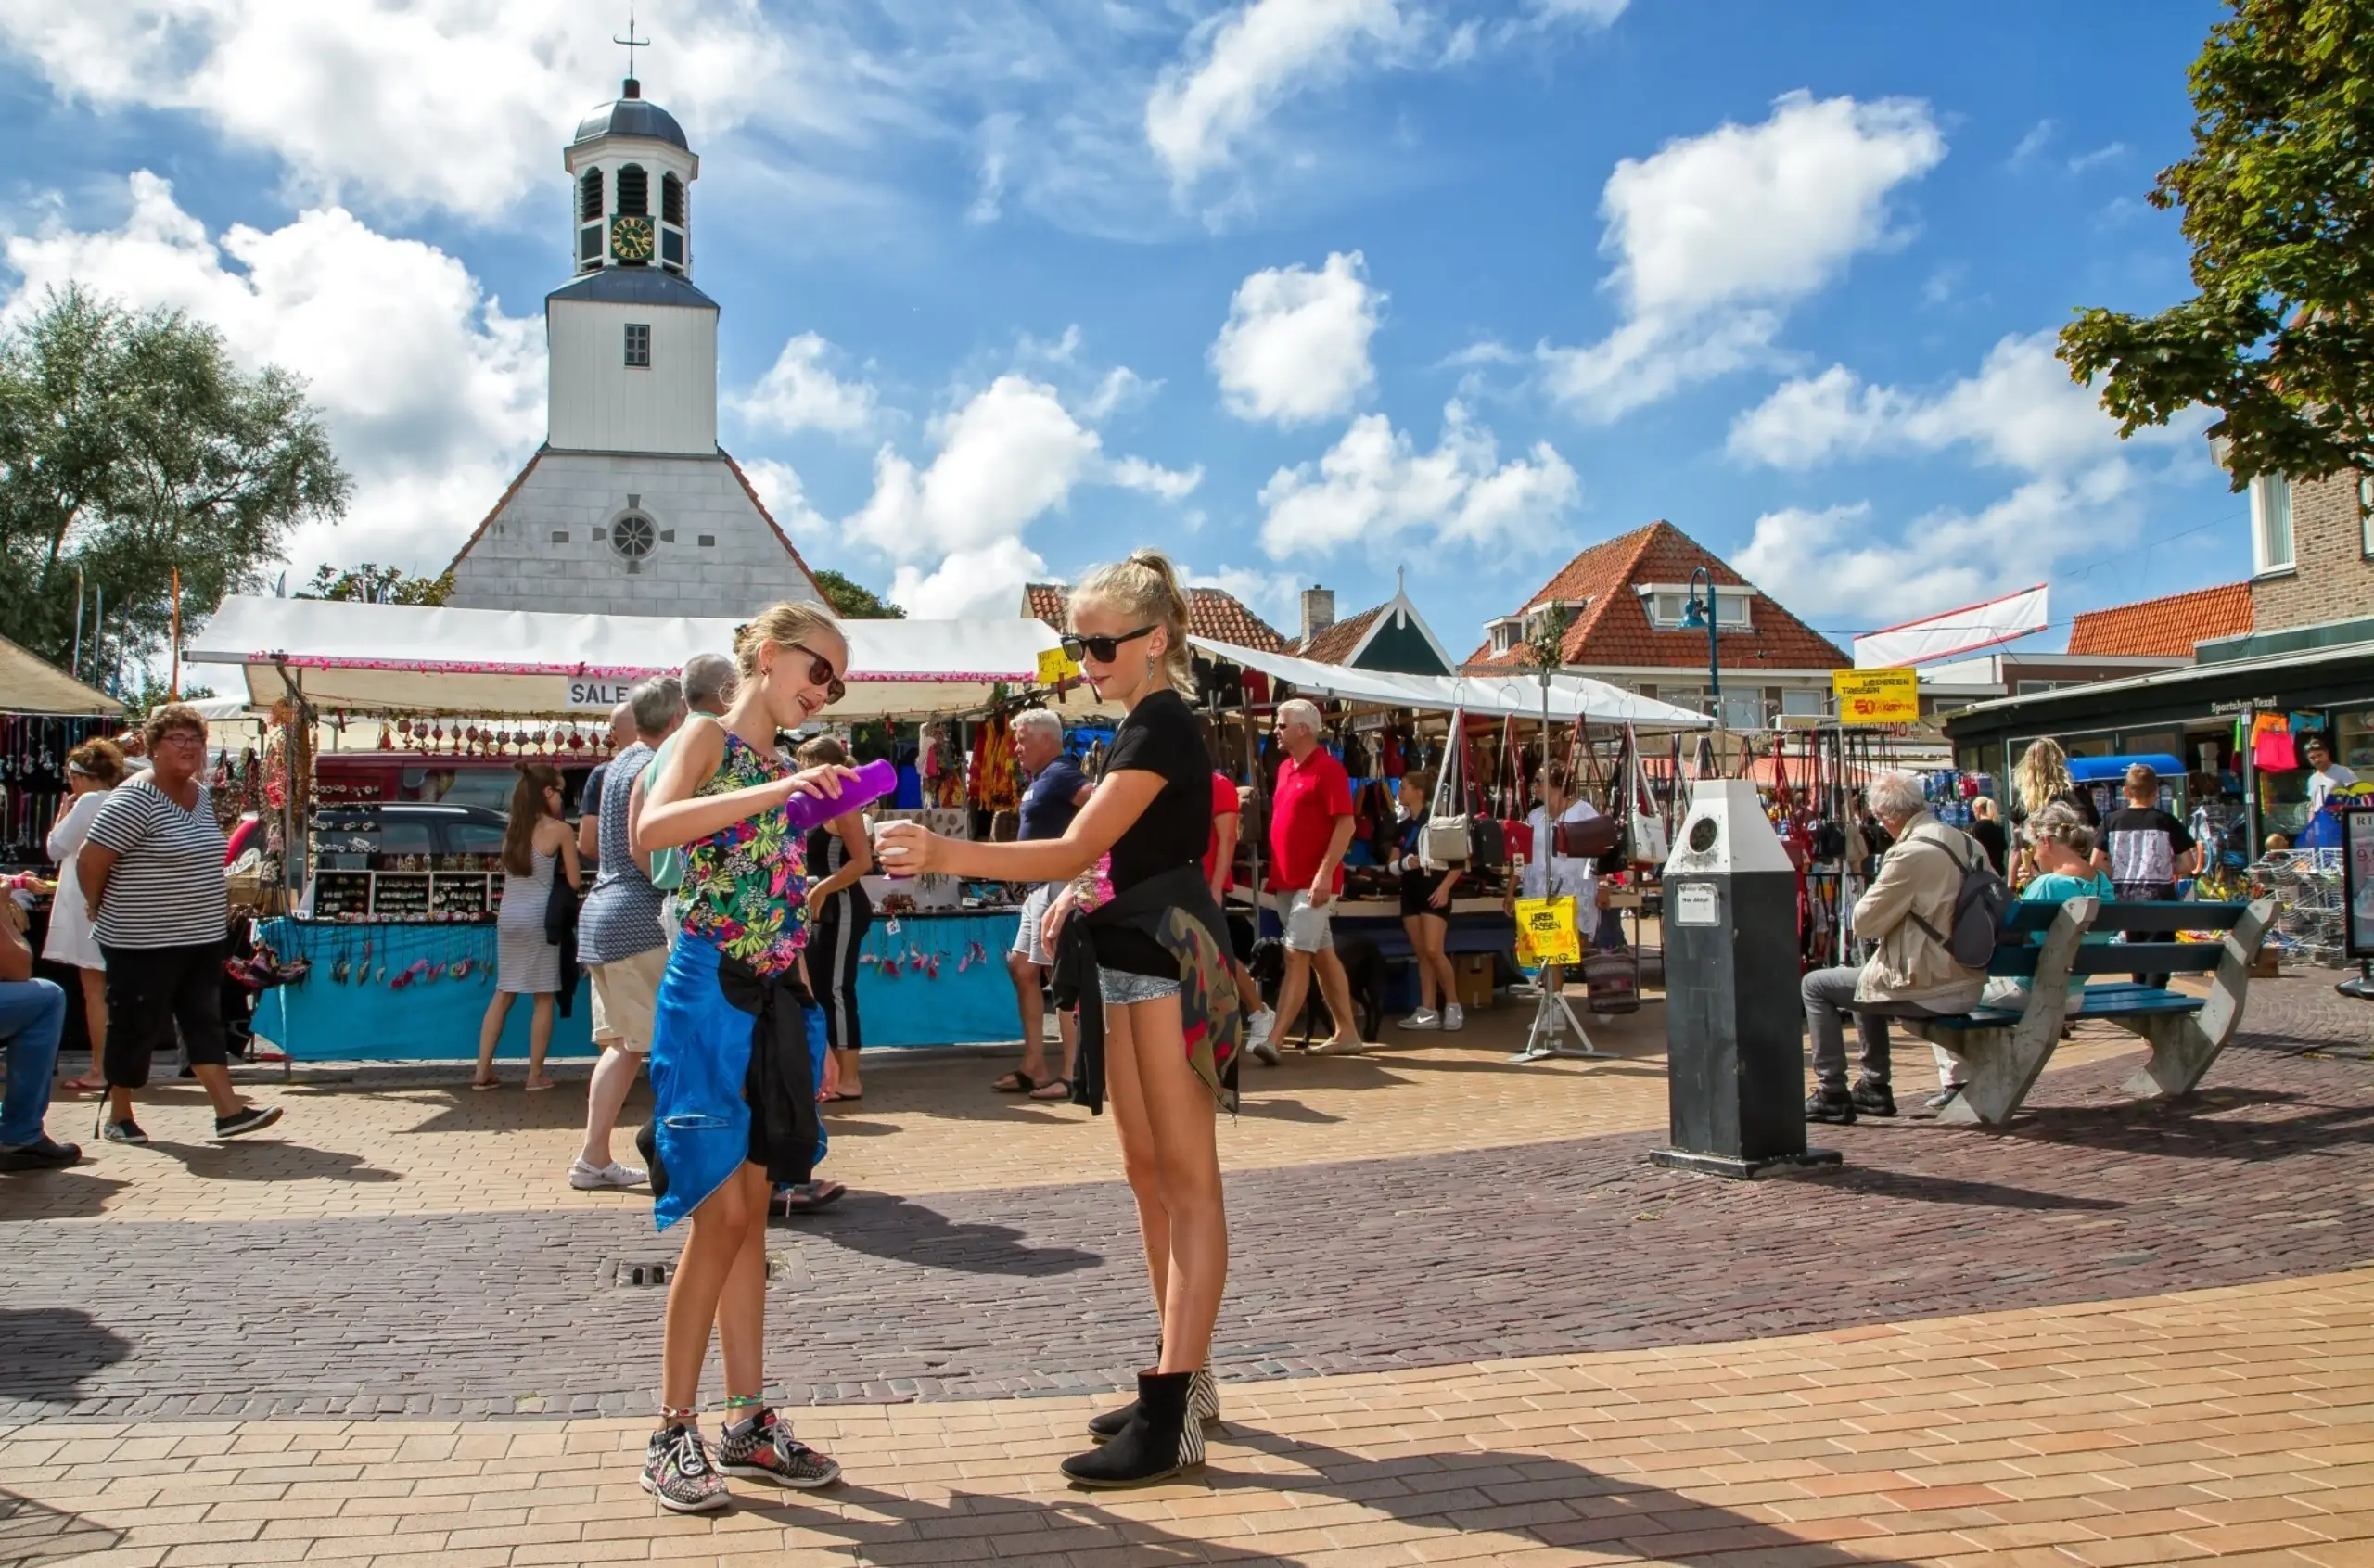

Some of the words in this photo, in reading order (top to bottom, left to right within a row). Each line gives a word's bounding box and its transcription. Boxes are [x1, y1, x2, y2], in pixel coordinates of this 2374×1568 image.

[571, 683, 629, 704] SALE
[2211, 699, 2253, 715] Sportshop
[2253, 695, 2278, 707] Texel
